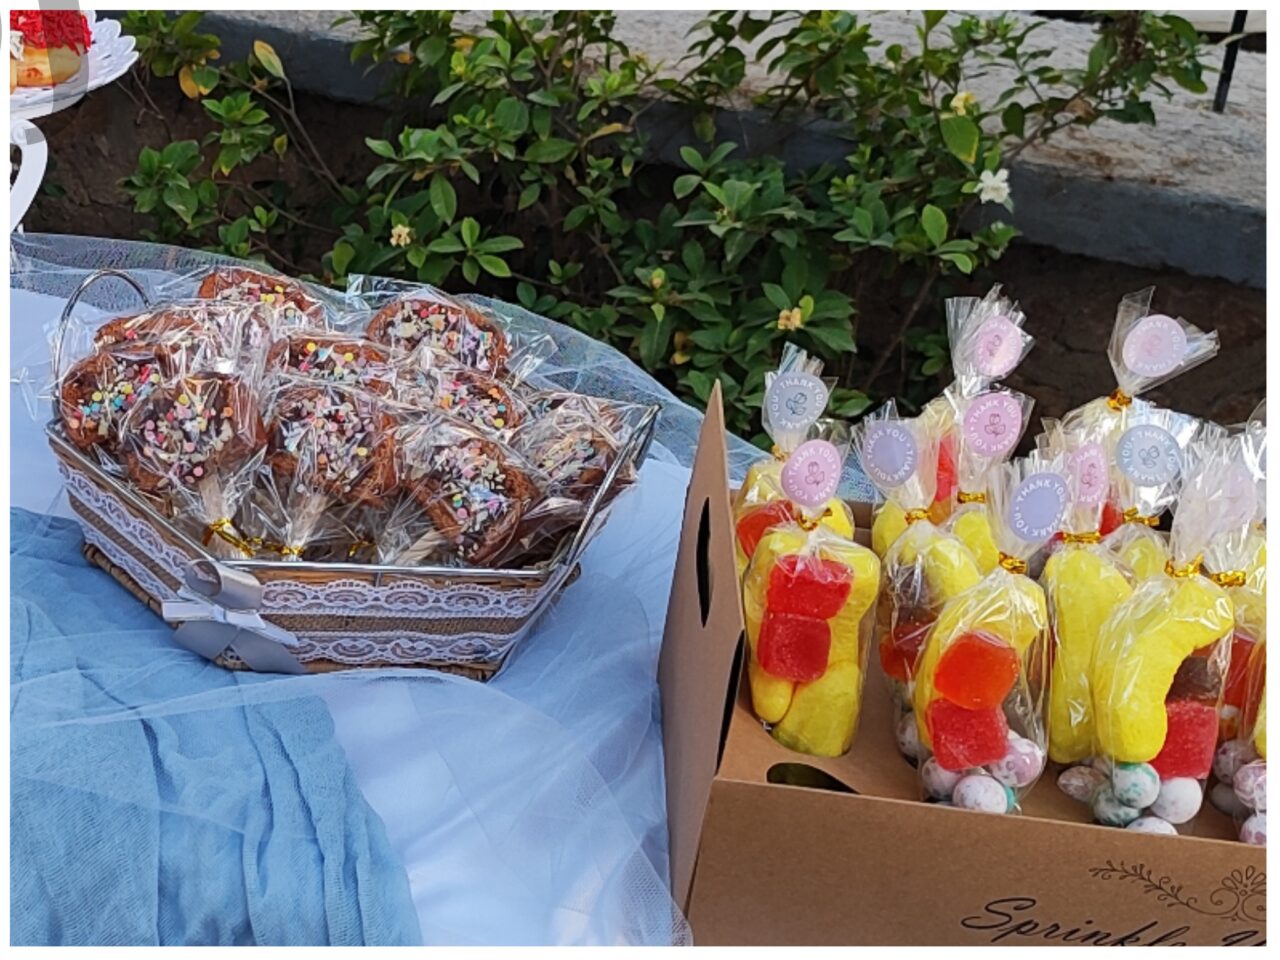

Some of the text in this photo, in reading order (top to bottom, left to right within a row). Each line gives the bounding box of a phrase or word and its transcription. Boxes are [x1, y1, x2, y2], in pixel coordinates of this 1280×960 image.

[971, 399, 999, 423] THANK
[1003, 399, 1018, 421] YOU
[868, 431, 884, 460] THANK
[885, 428, 907, 442] YOU
[789, 446, 816, 476] THANK
[818, 446, 835, 463] YOU
[1016, 479, 1052, 503] THANK
[1053, 480, 1066, 502] YOU
